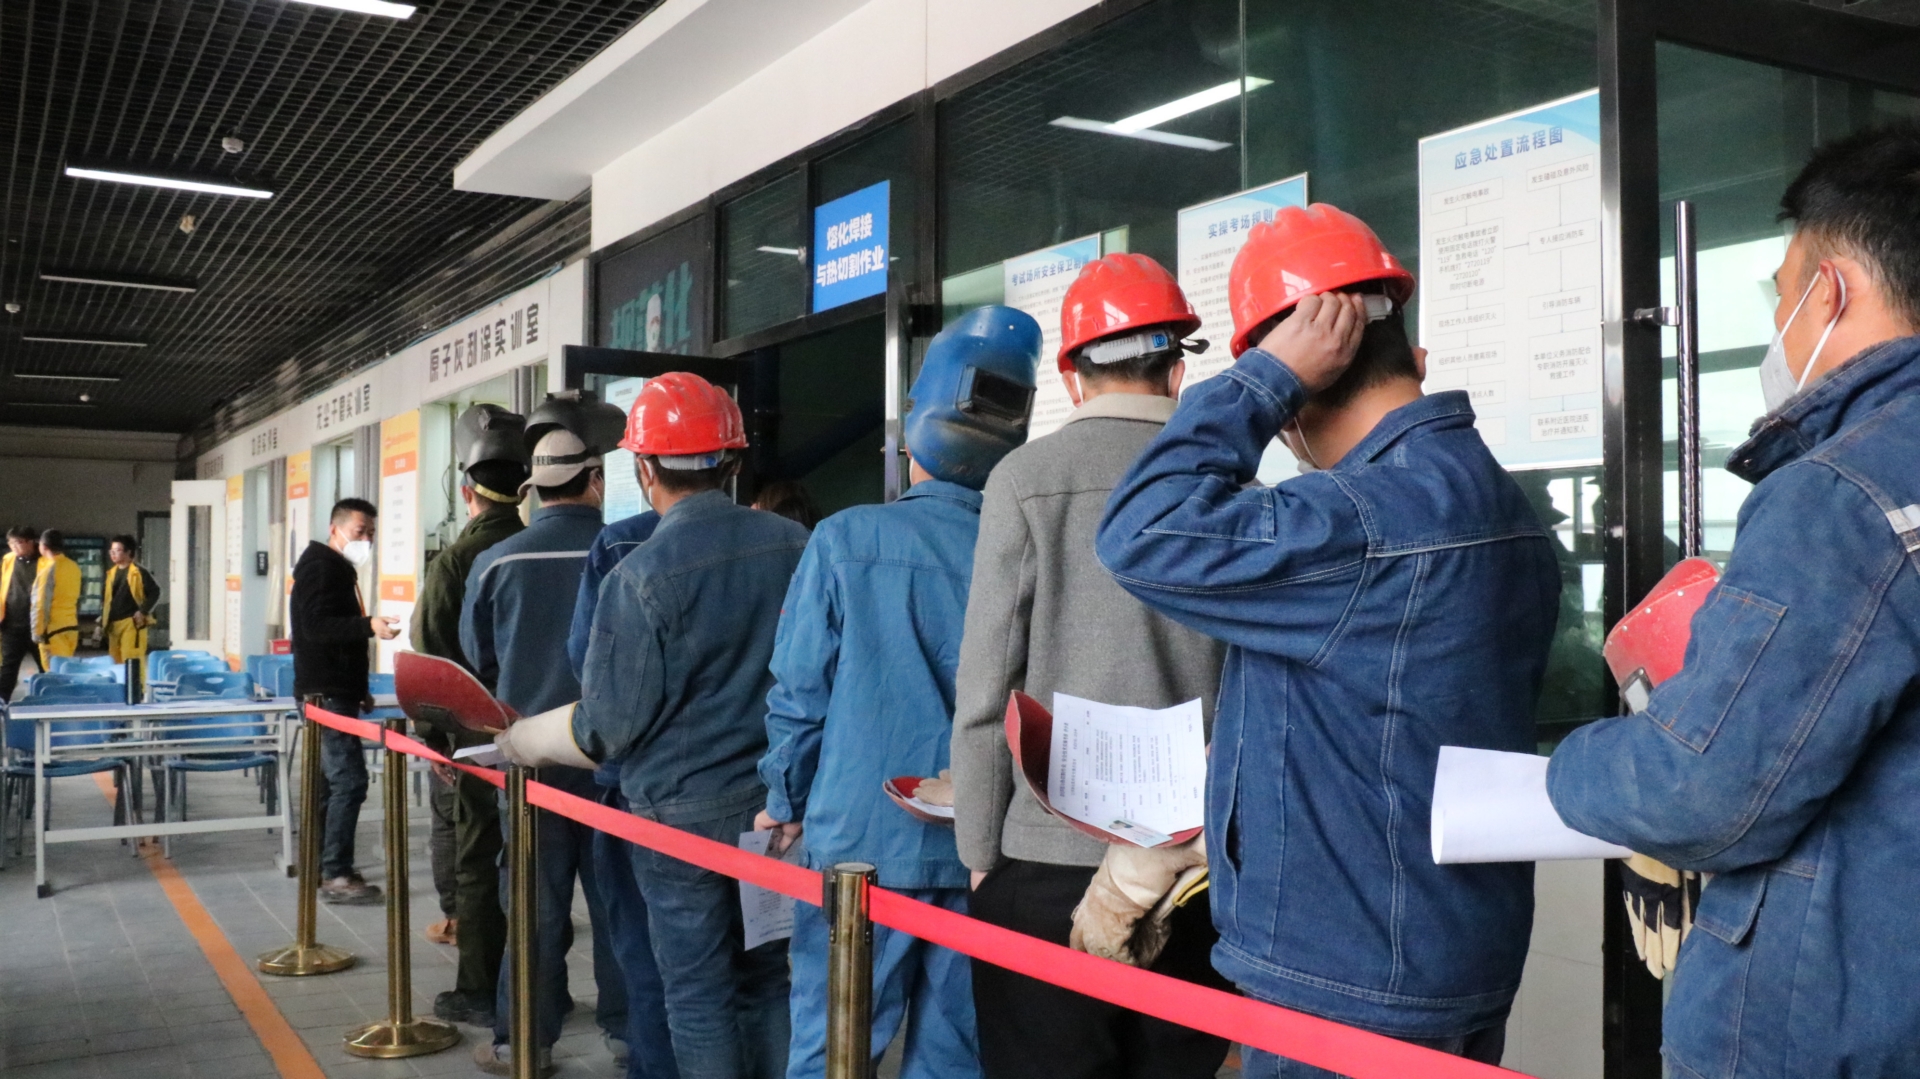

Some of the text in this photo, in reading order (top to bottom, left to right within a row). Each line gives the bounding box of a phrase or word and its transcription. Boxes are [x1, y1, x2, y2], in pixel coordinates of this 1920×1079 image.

[1454, 125, 1563, 170] 应急处置流程图
[826, 211, 873, 251] 熔化焊接
[1208, 207, 1273, 239] 实操考场规则
[816, 244, 884, 287] 与热切割作业
[430, 302, 539, 383] 原子灰刮涂实训室
